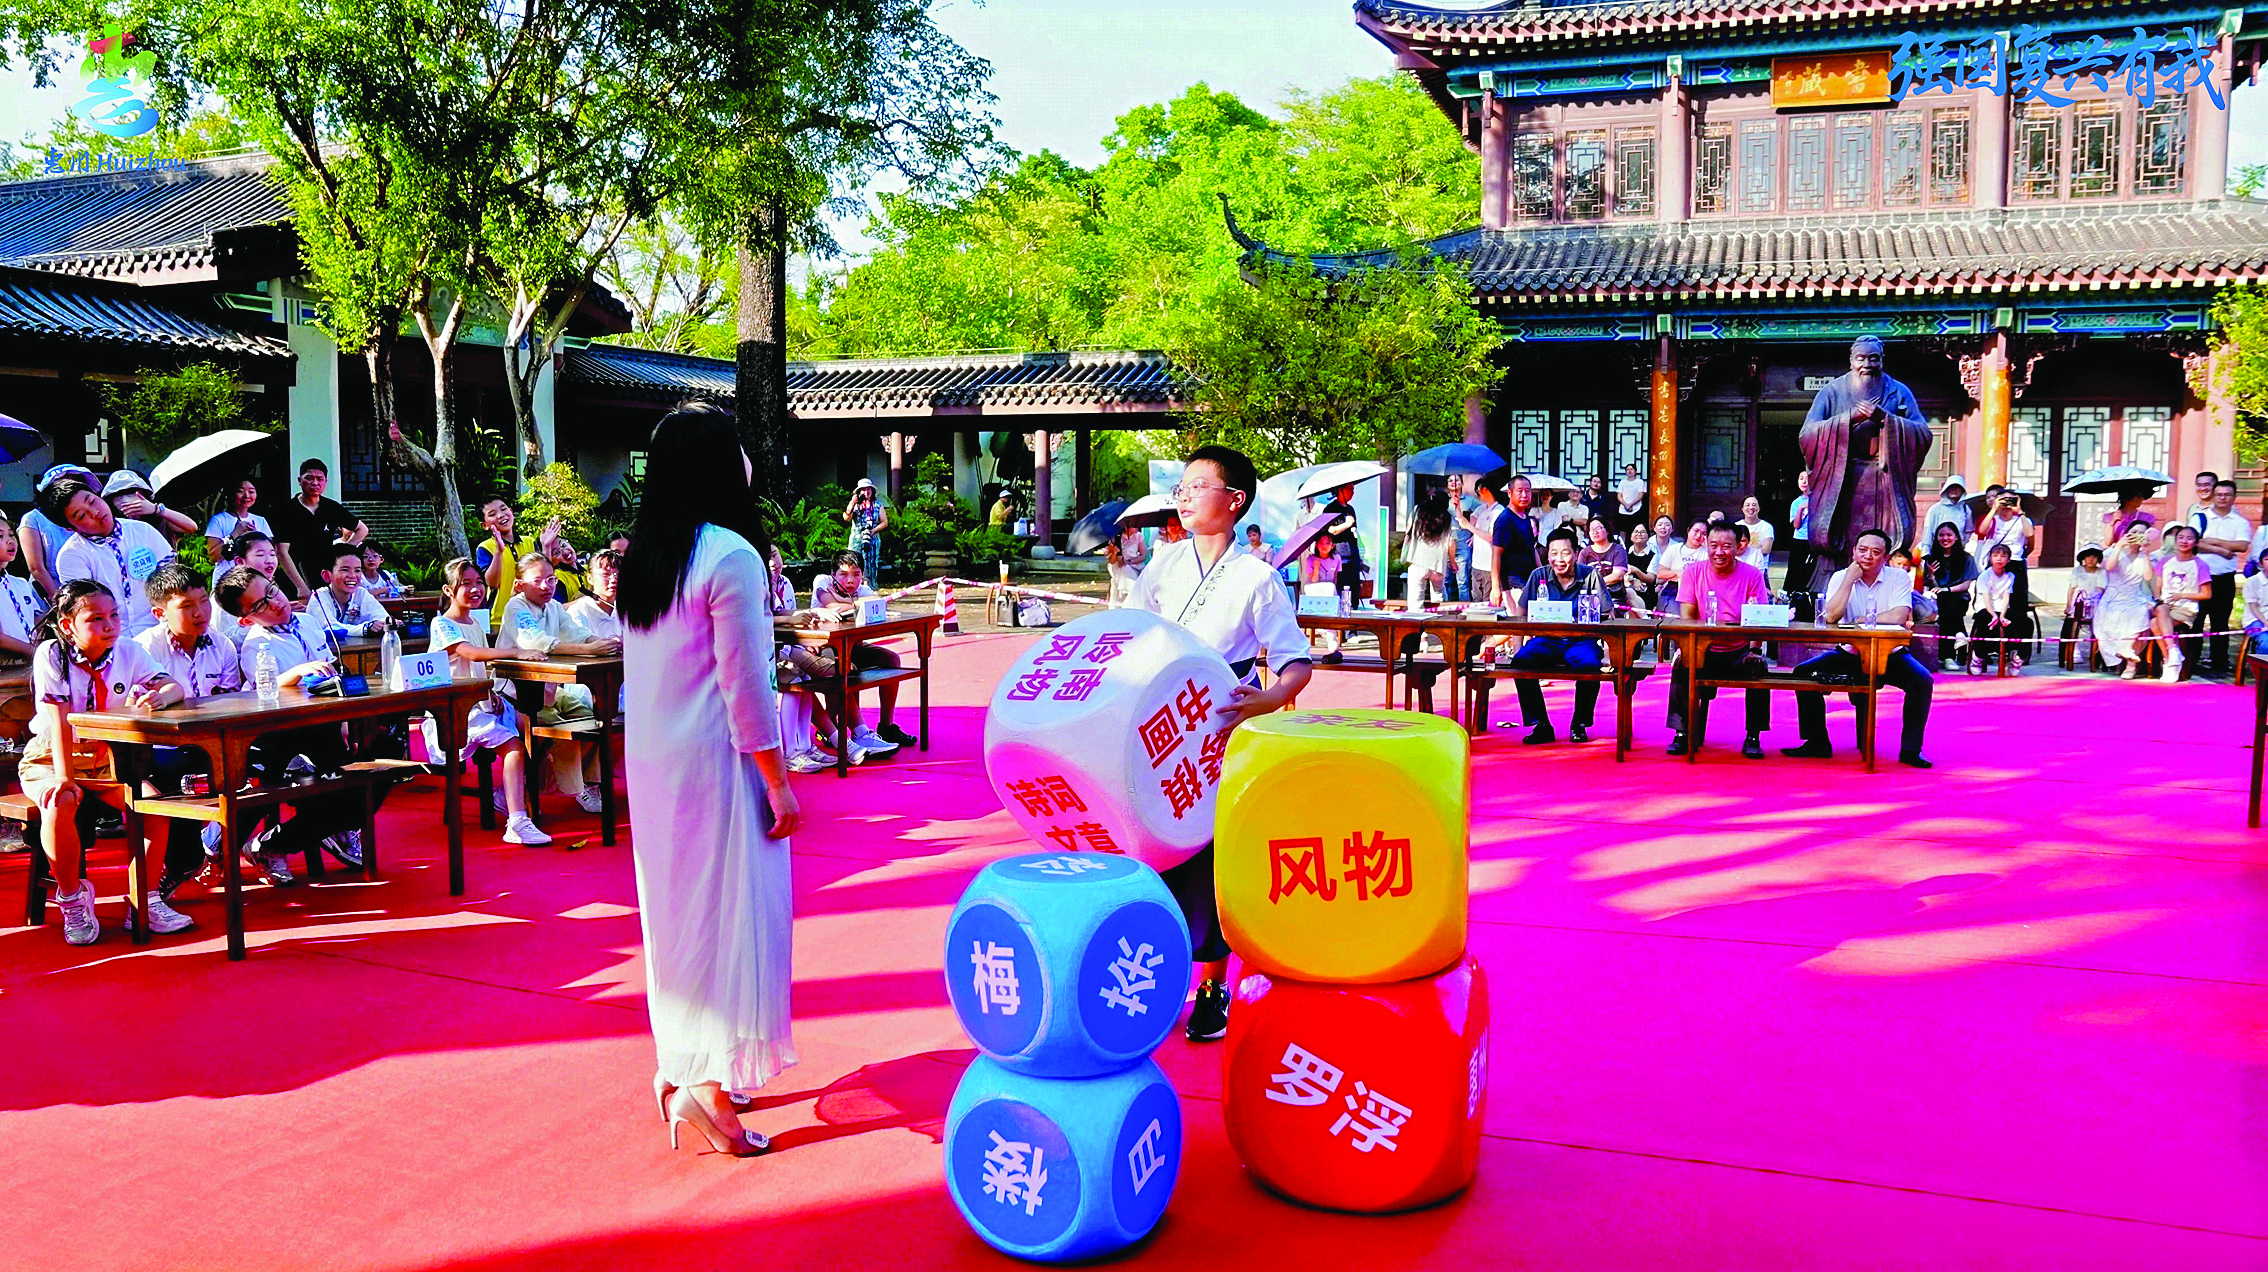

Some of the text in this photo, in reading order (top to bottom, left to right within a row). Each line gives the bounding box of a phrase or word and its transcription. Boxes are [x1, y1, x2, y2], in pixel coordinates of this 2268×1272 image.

[871, 604, 880, 615] 10
[417, 660, 434, 676] 06
[1007, 634, 1086, 701] 风物
[1053, 632, 1134, 701] 岭南
[1138, 678, 1212, 769] 书画
[1006, 775, 1088, 818] 诗词
[1161, 731, 1229, 821] 琴棋
[1045, 821, 1126, 855] 文章
[1268, 830, 1413, 905] 风物
[970, 940, 1021, 1016] 梅
[1099, 936, 1164, 1017] 茶
[1265, 1042, 1412, 1152] 罗浮
[982, 1129, 1048, 1216] 楼
[1128, 1118, 1165, 1196] 月
